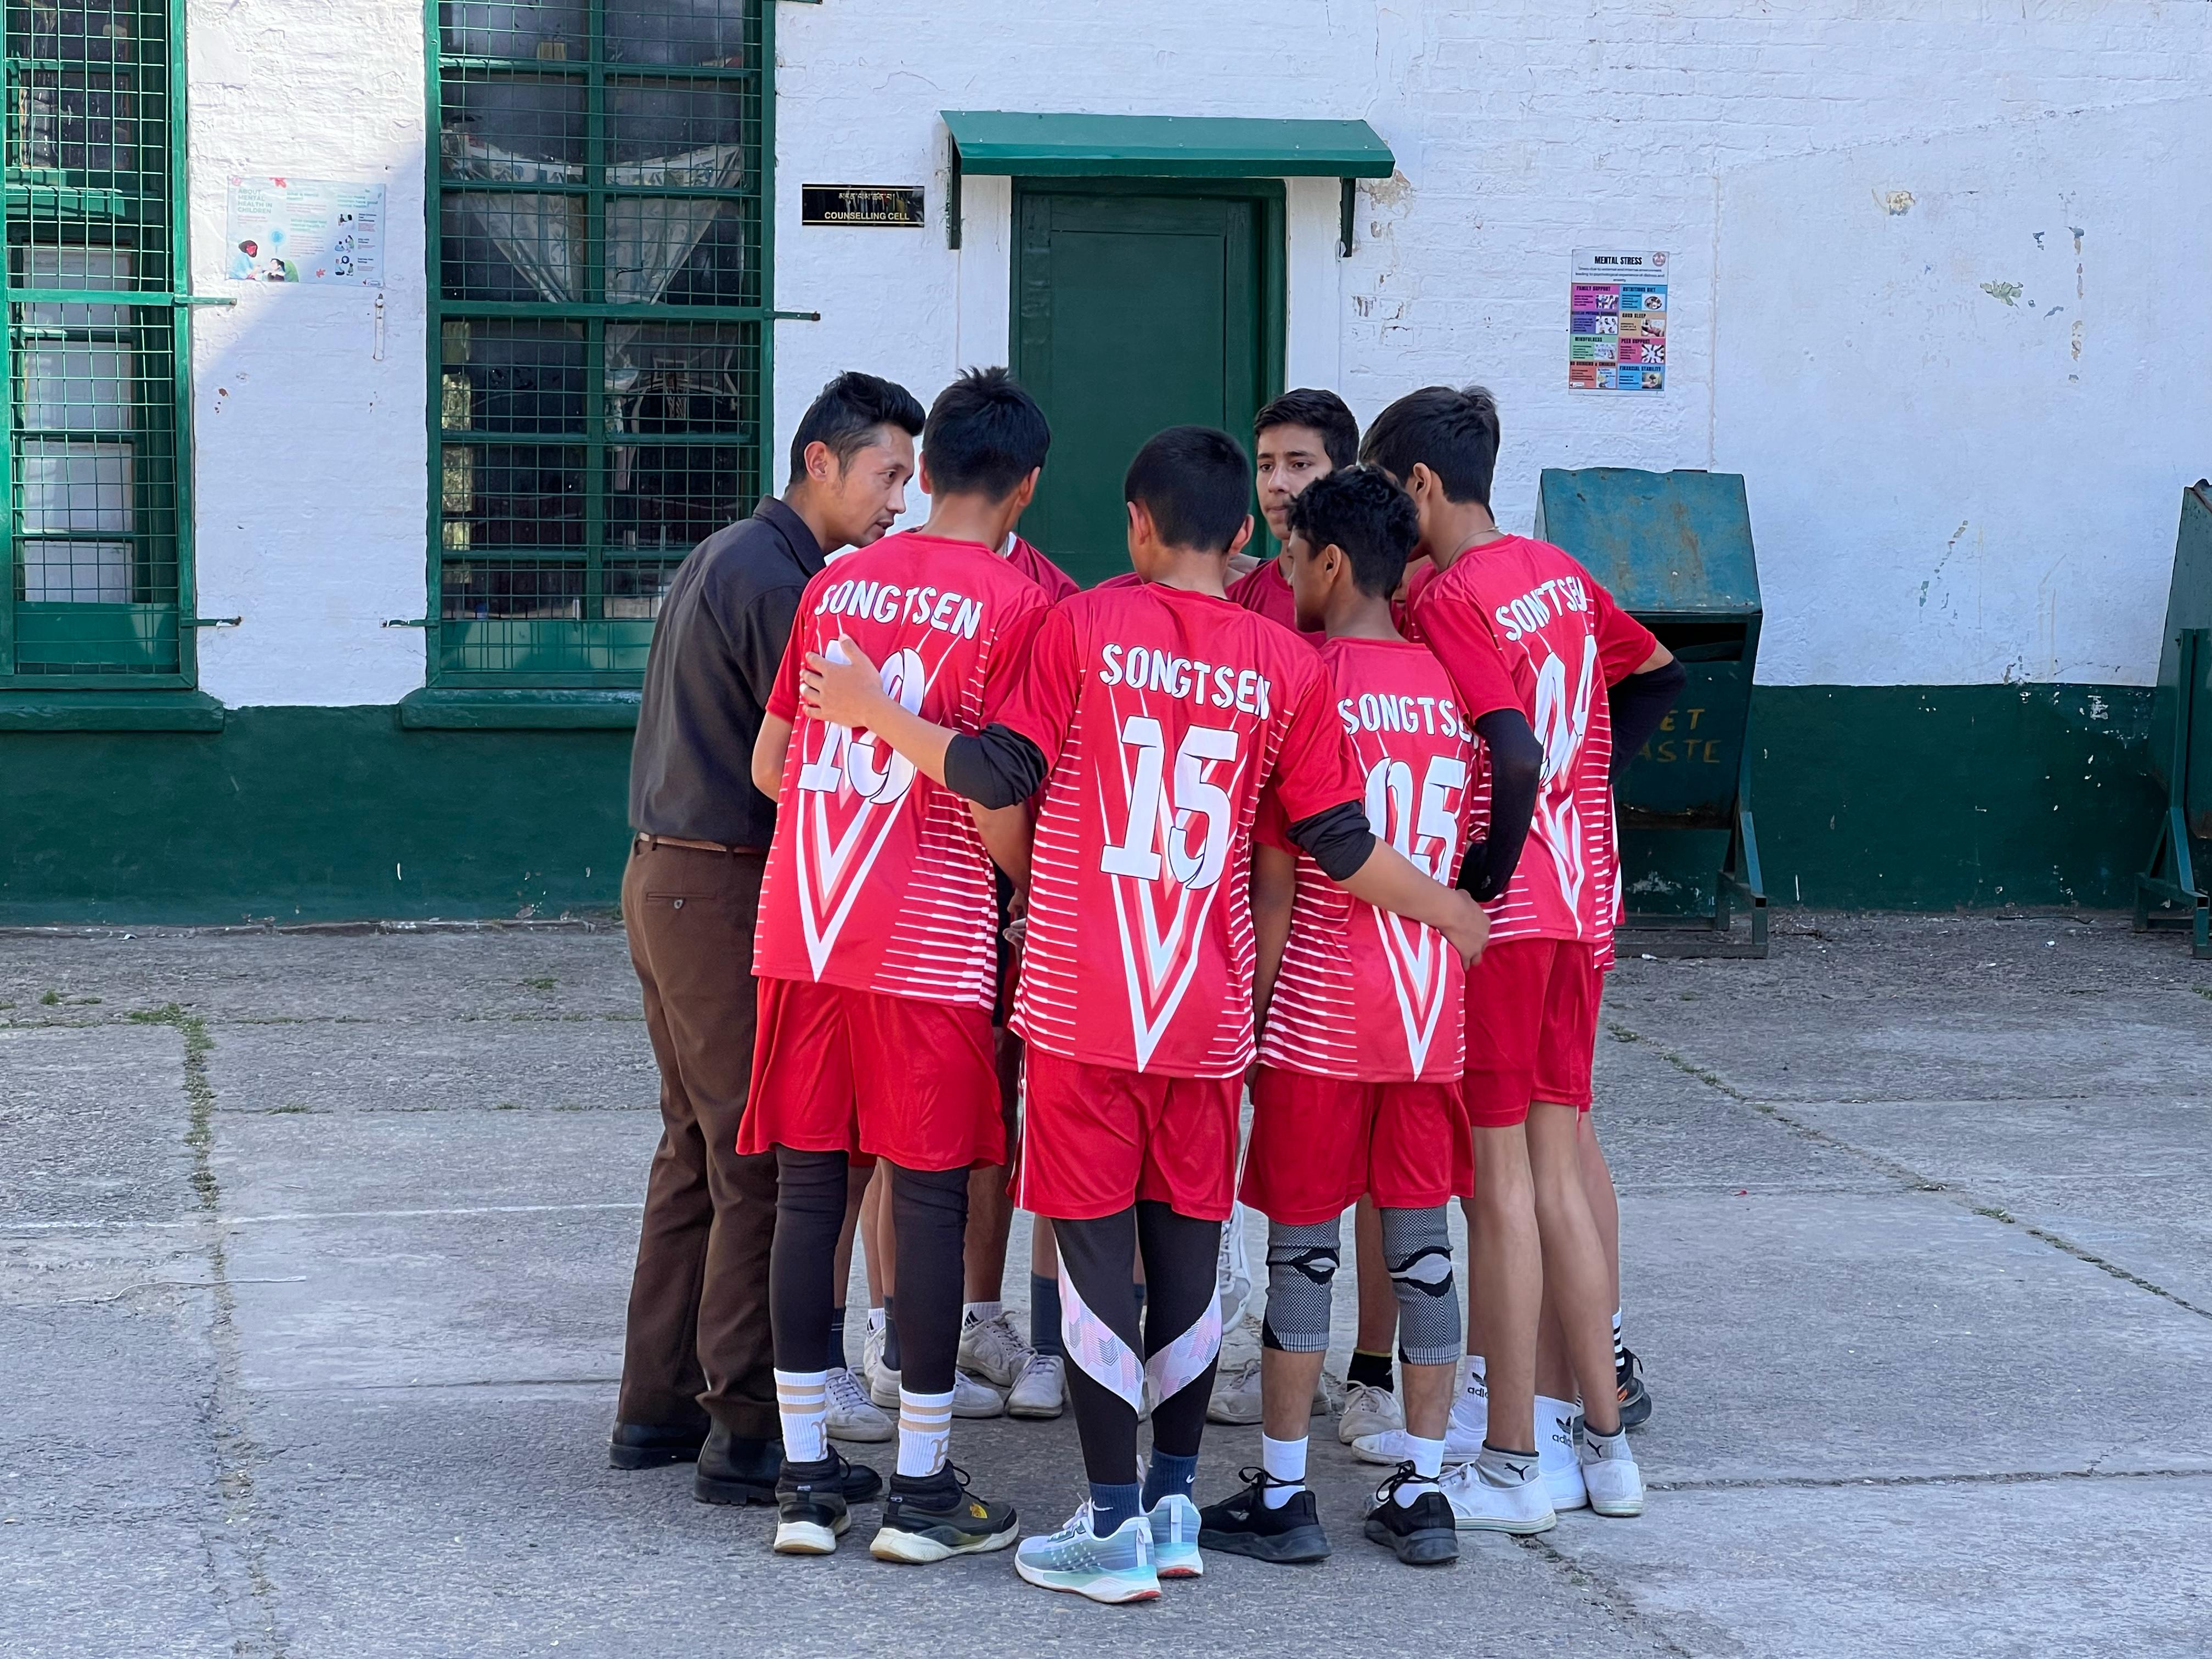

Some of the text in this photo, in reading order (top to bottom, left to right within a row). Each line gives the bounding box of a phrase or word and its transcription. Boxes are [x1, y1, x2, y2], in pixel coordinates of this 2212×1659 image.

[824, 212, 910, 221] COUNSELLING CELL
[1594, 256, 1642, 265] MENTAL STRESS
[814, 579, 984, 640] SONGTSEN
[1098, 643, 1272, 720] SONGTSEN
[1660, 708, 1706, 731] ET
[1638, 740, 1722, 763] ASTE
[1099, 715, 1240, 890] 15
[1364, 754, 1468, 887] 05
